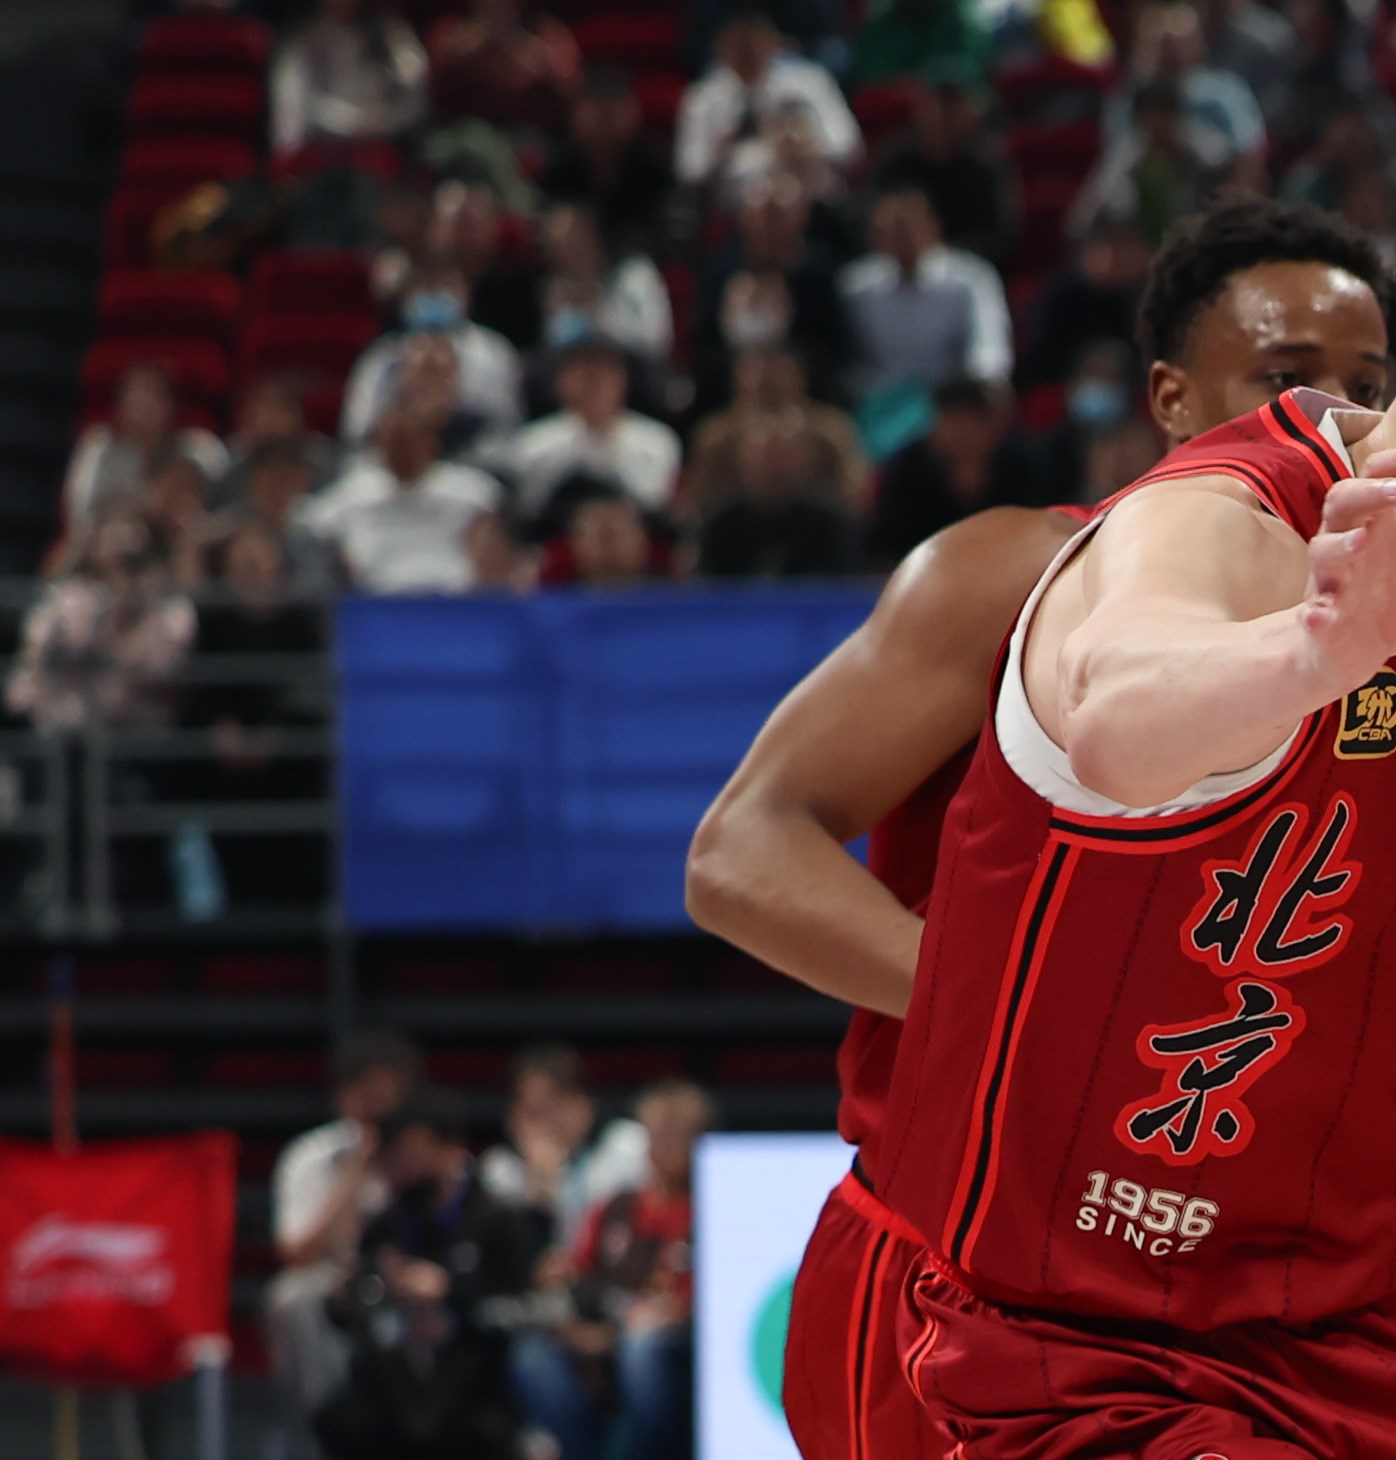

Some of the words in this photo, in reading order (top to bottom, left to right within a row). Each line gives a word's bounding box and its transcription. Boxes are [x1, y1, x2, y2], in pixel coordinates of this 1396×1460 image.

[1358, 728, 1393, 741] CBA
[1081, 1169, 1221, 1239] 1956
[1075, 1206, 1203, 1257] SINCE
